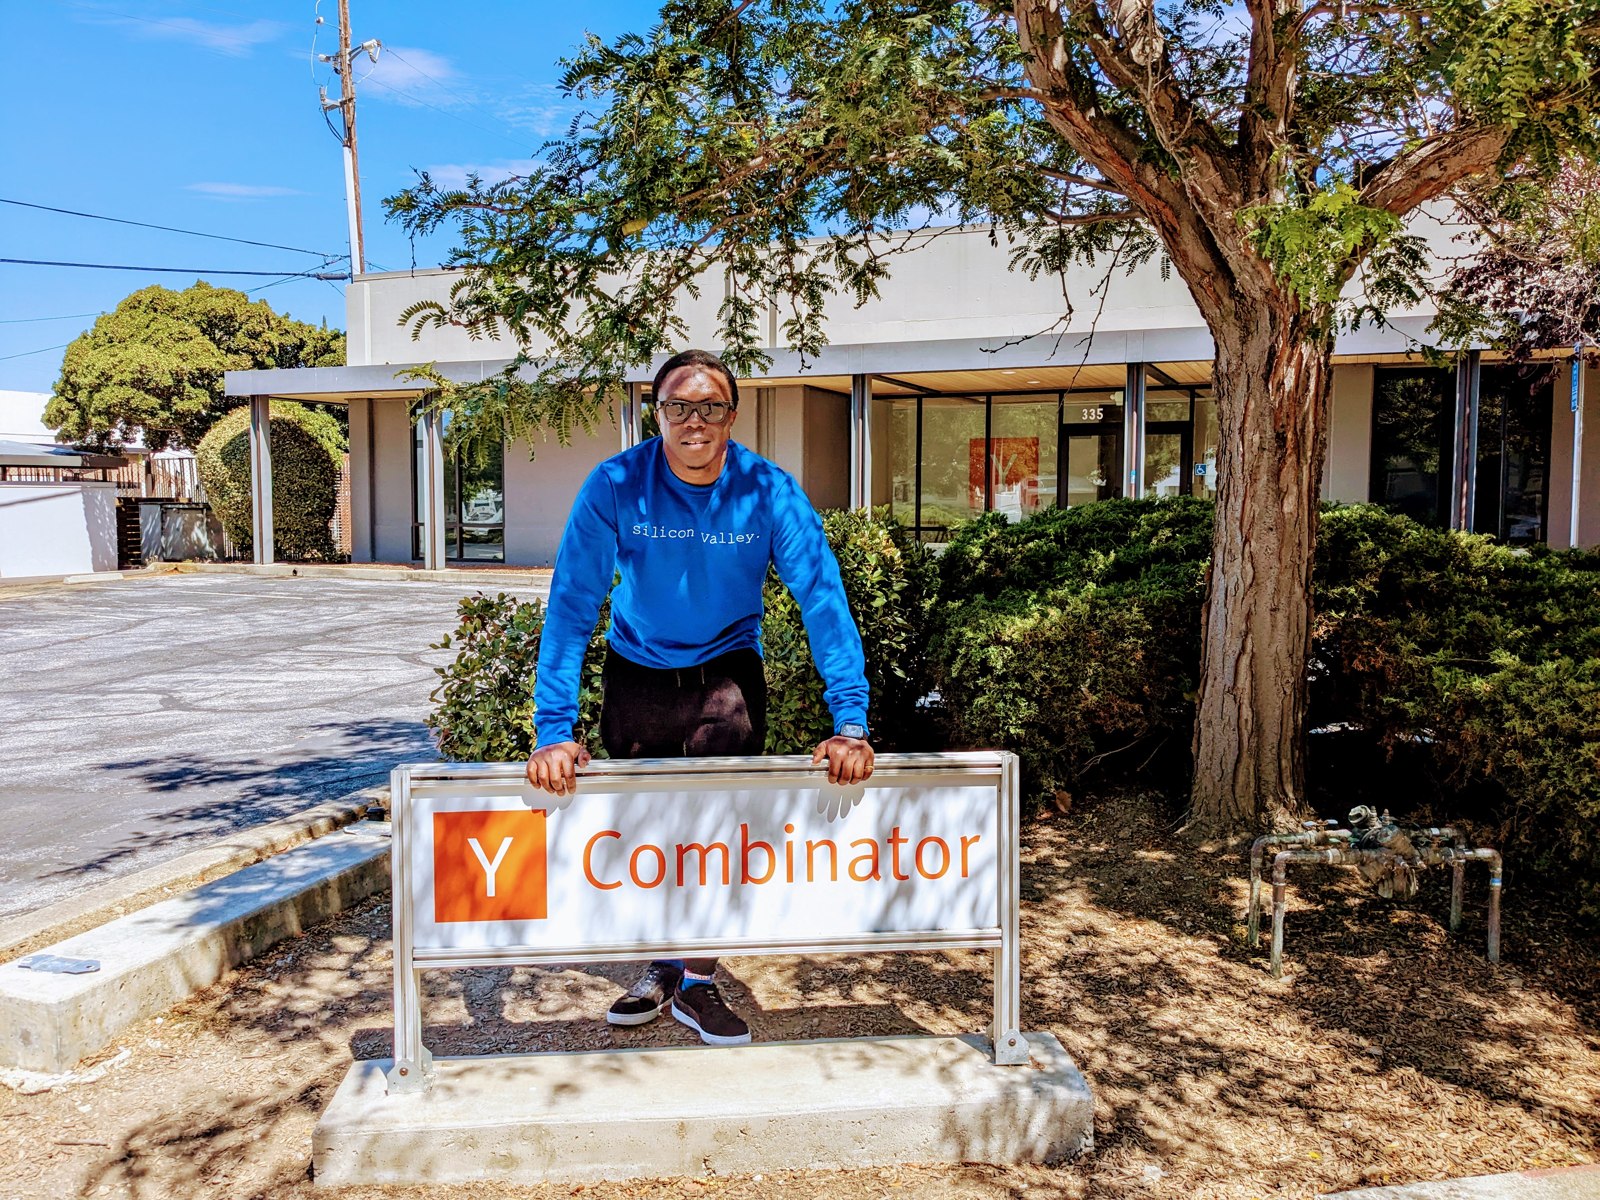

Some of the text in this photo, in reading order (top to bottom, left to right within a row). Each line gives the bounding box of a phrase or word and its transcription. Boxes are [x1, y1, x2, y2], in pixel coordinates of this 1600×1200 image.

[1082, 408, 1104, 420] 335
[990, 452, 1018, 490] Y
[467, 823, 981, 897] Y Combinator
